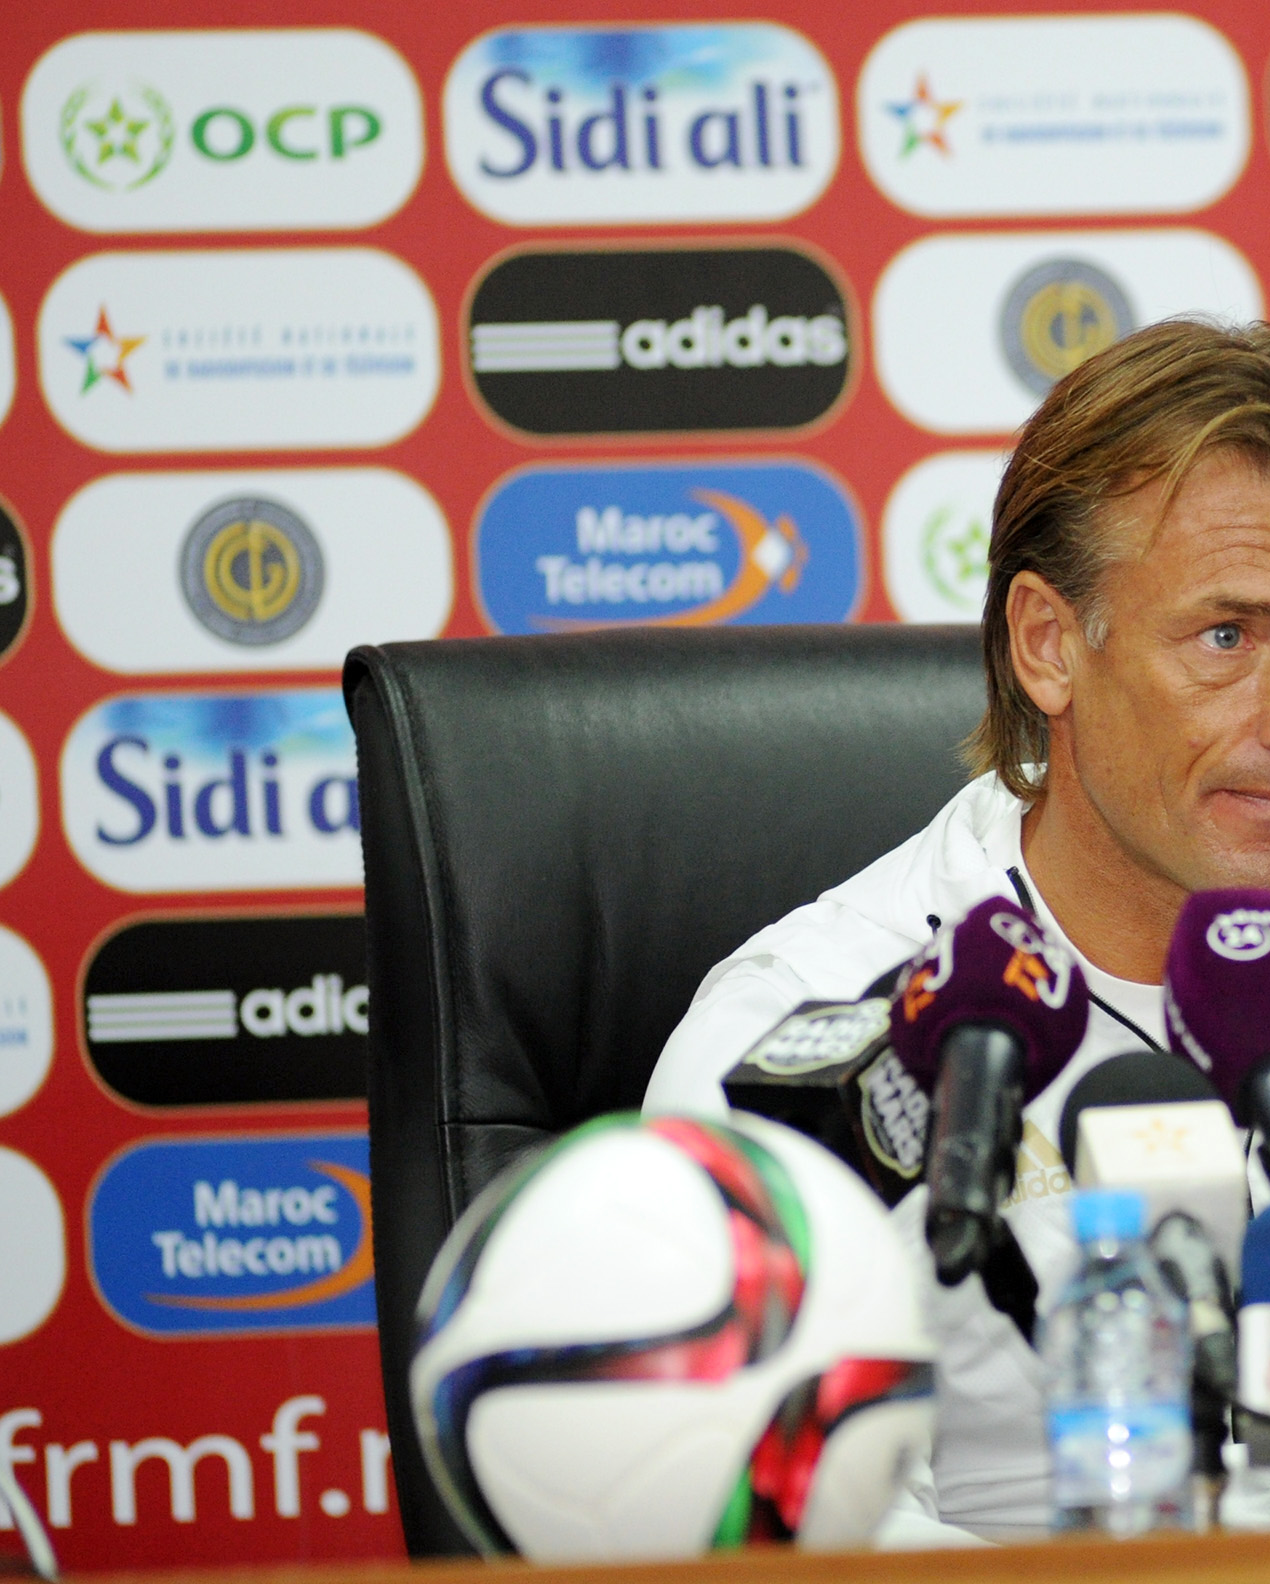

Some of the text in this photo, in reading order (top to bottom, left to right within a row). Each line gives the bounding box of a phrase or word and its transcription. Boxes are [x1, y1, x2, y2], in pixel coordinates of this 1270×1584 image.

[190, 105, 383, 163] OCP
[478, 65, 806, 180] Sidi ali
[620, 305, 848, 371] adidas
[576, 506, 718, 552] Maroc
[537, 554, 724, 605] Telecom
[96, 734, 283, 846] Sidi
[240, 972, 369, 1038] adi
[193, 1180, 338, 1228] Maroc
[152, 1230, 342, 1281] Telecom
